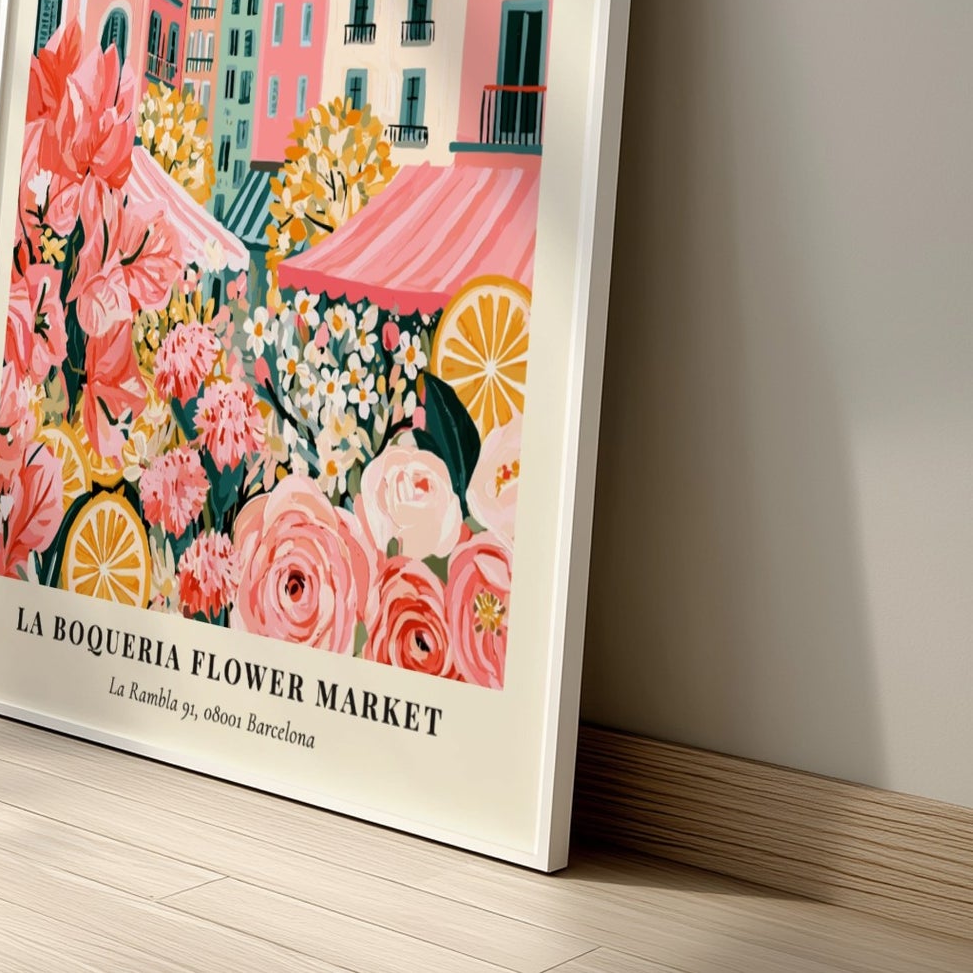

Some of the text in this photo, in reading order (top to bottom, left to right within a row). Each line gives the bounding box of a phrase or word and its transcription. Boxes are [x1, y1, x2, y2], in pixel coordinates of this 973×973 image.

[16, 607, 443, 736] LA BOQUERIA FLOWER MARKET
[109, 676, 316, 749] La Rambla 91, 08001 Barcelona
